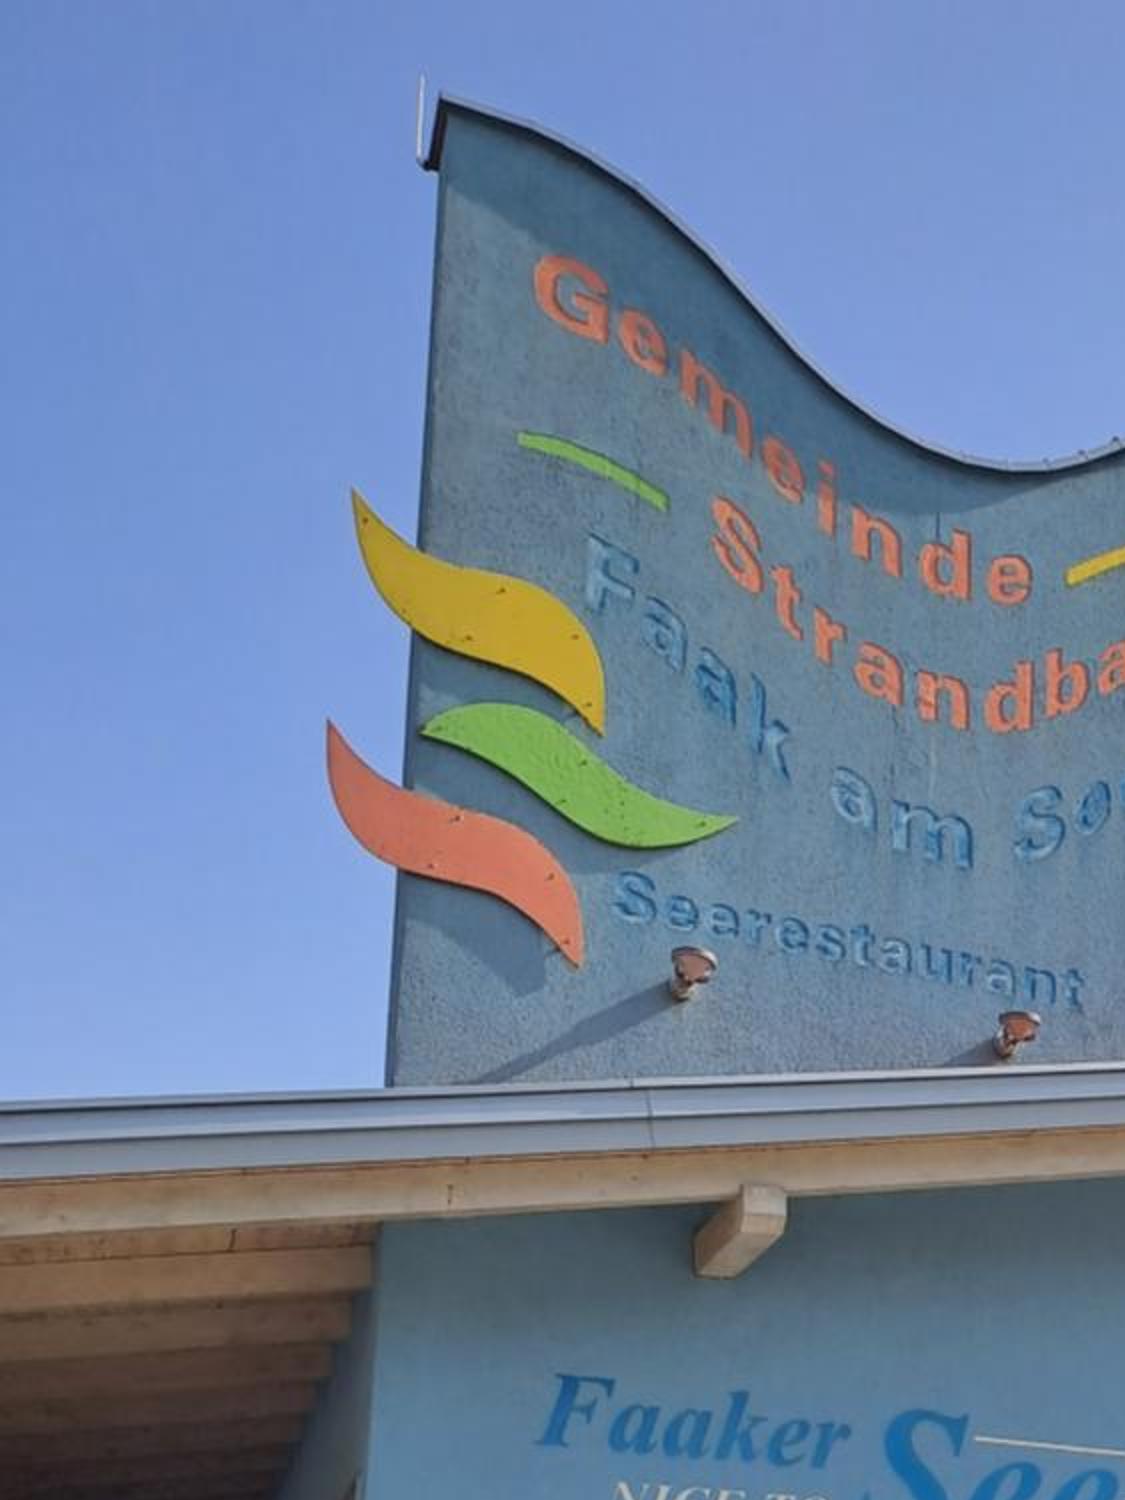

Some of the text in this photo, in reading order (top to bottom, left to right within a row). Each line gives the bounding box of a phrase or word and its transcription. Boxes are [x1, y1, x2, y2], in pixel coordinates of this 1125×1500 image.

[533, 253, 1033, 604] Gemeinde
[585, 530, 792, 781] Faak
[829, 765, 976, 871] am
[612, 870, 1087, 1009] Seerestaurant
[534, 1372, 852, 1469] Faaker
